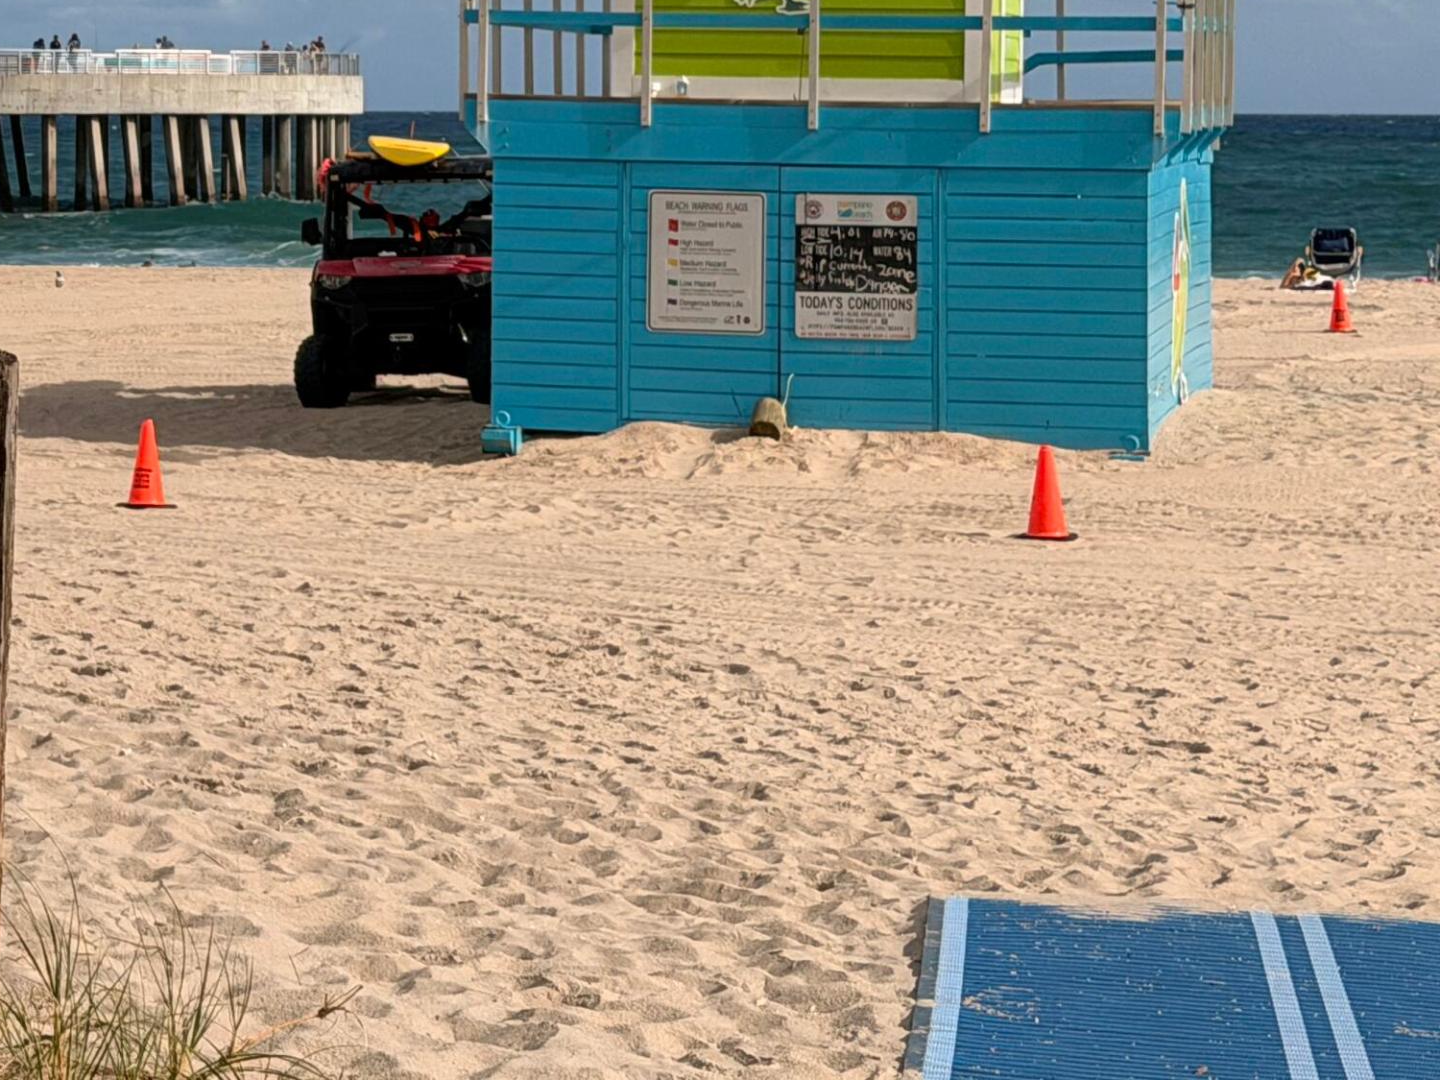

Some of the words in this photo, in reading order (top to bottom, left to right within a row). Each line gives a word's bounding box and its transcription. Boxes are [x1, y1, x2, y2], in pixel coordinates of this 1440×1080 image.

[665, 201, 689, 211] BEACH
[691, 201, 723, 212] WARNING
[726, 202, 749, 213] FLAGS
[694, 280, 716, 288] Hazard
[800, 295, 843, 309] TODAY'S
[848, 296, 913, 311] CONDITIONS
